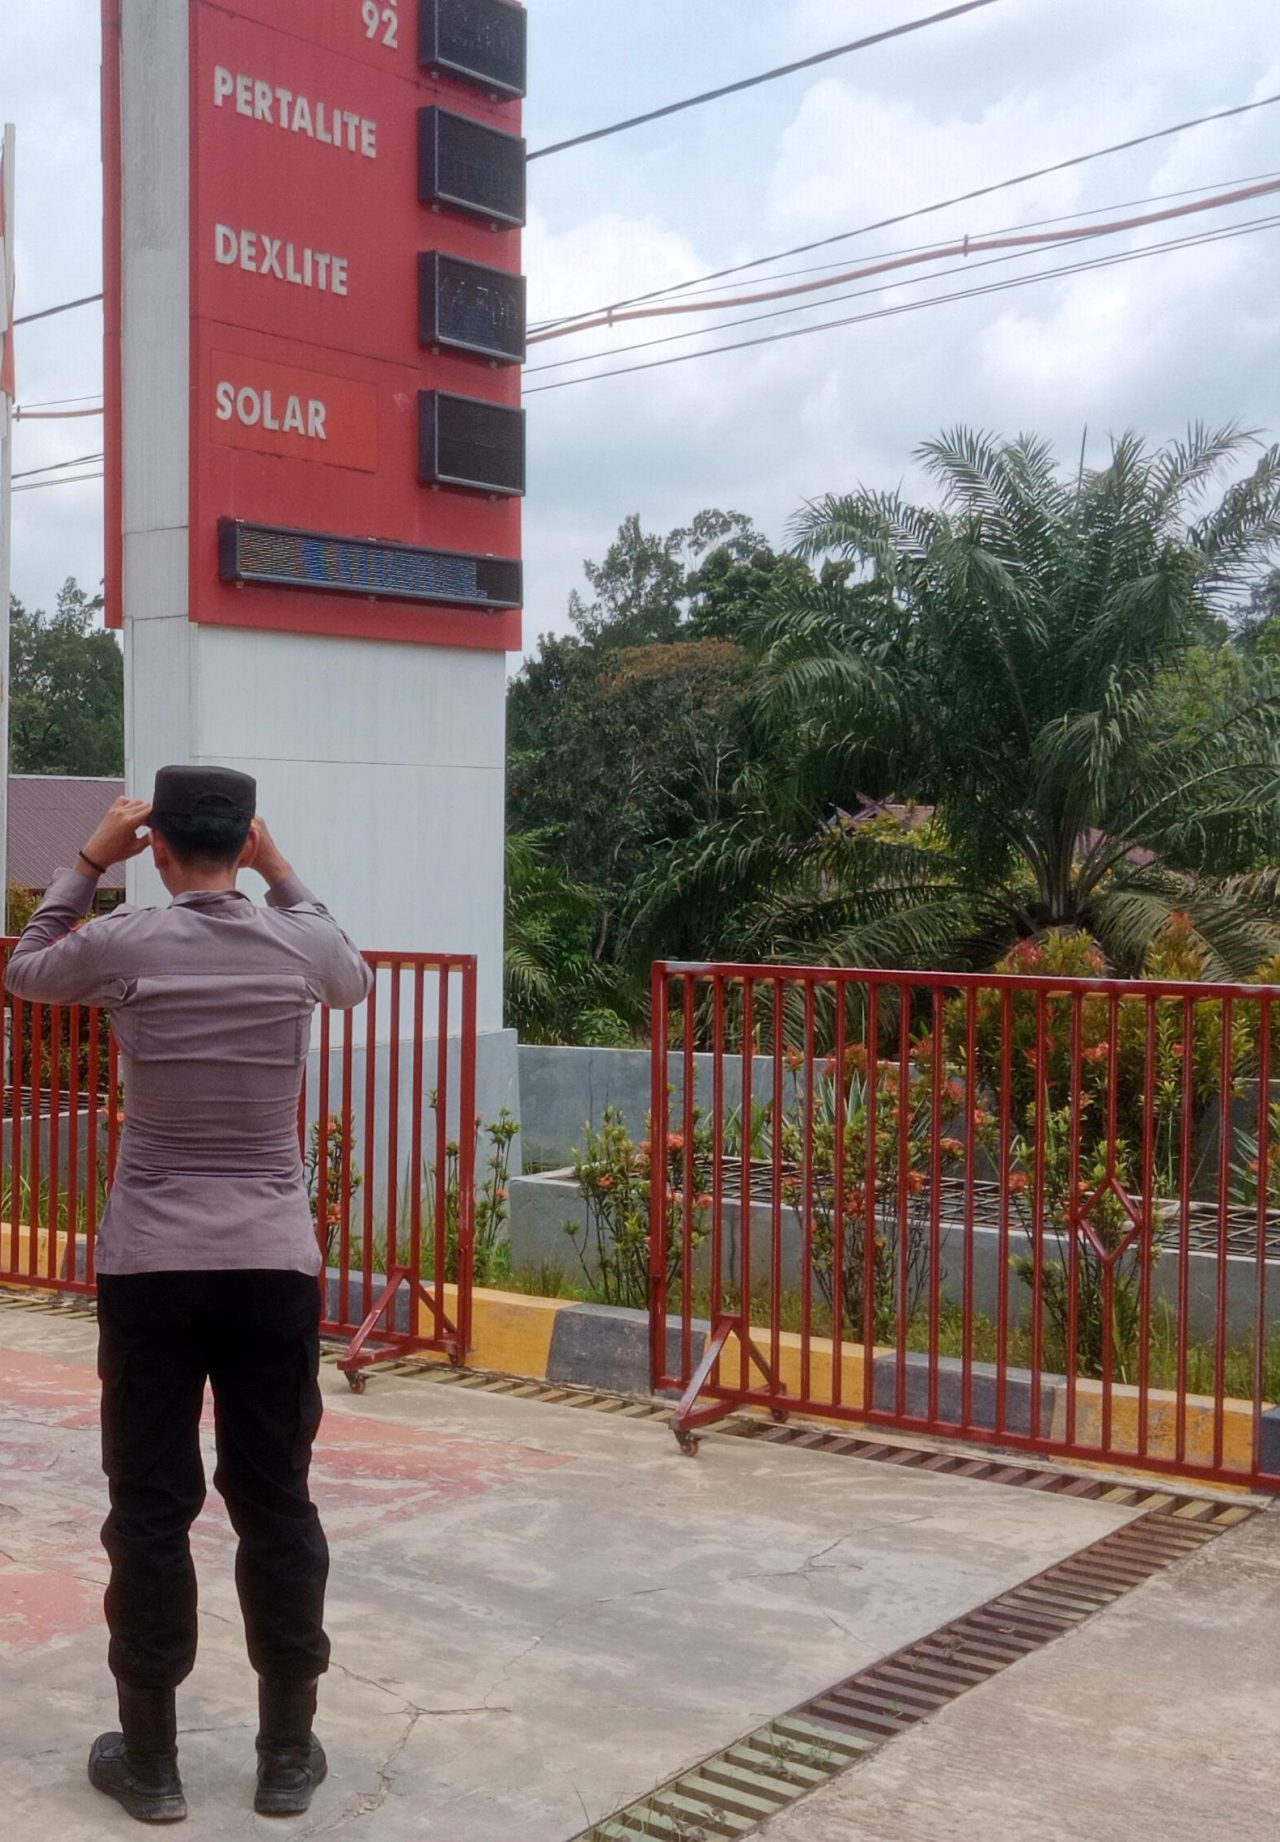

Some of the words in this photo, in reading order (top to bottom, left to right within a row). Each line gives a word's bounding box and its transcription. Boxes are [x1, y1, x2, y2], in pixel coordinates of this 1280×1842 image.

[362, 0, 398, 49] 92
[214, 65, 376, 158] PERTALITE
[214, 223, 347, 296] DEXLITE
[216, 381, 327, 440] SOLAR
